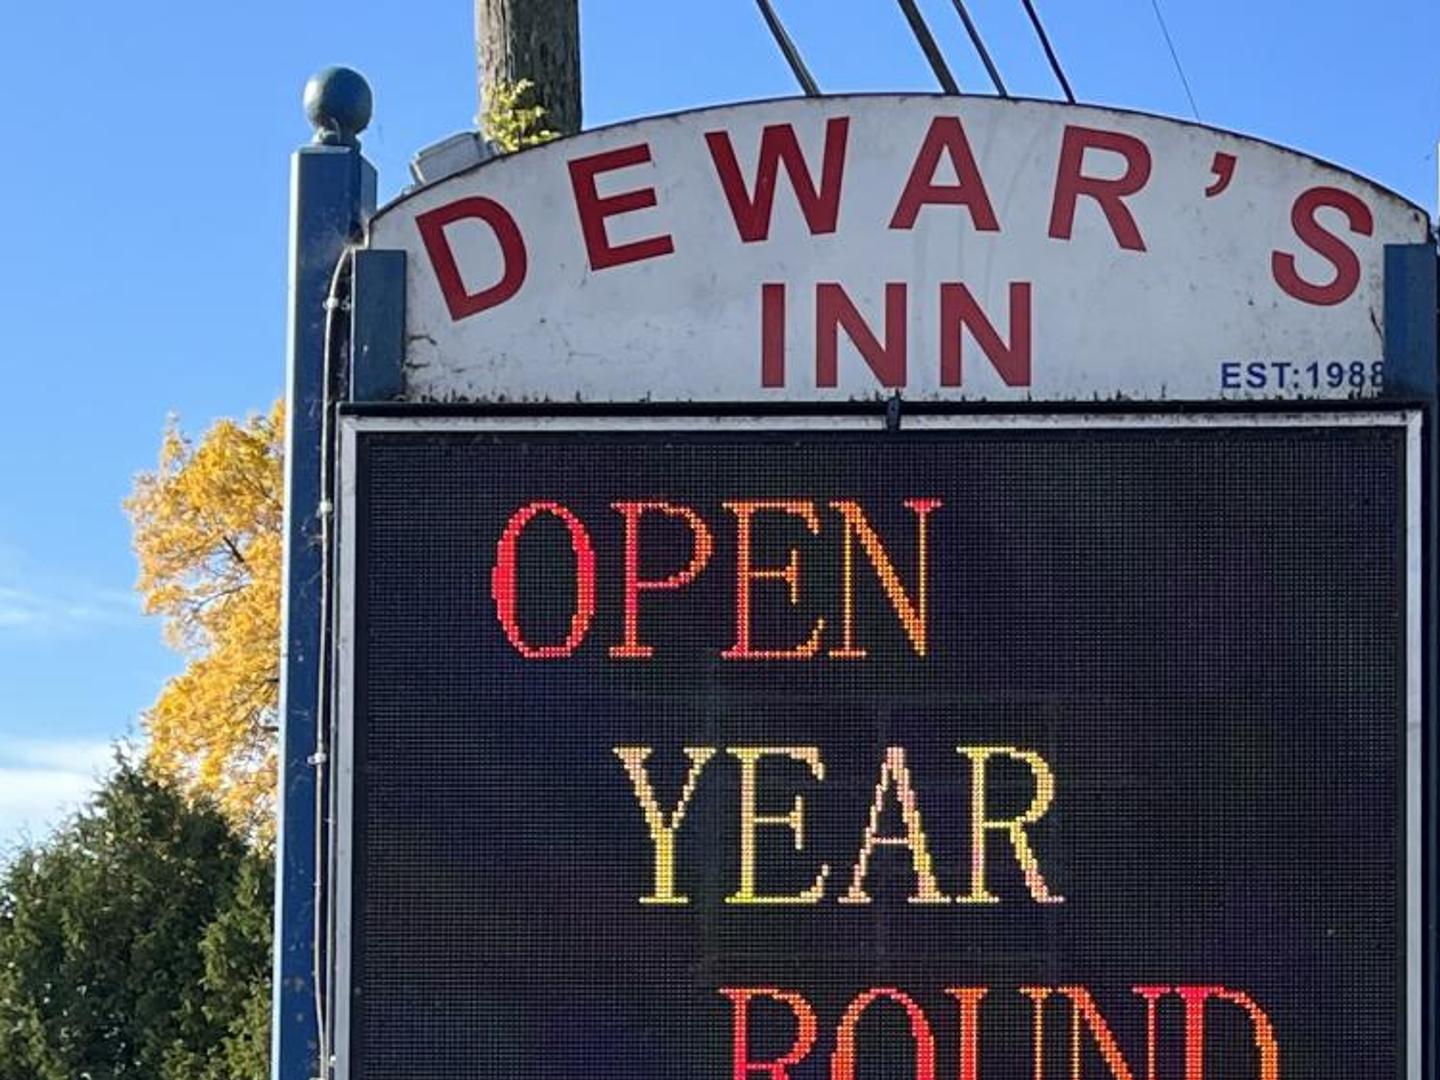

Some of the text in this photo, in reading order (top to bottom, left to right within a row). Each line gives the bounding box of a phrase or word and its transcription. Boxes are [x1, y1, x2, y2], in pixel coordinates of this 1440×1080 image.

[415, 115, 1374, 321] DEWAR'S
[761, 281, 1032, 389] INN
[491, 498, 943, 659] OPEN
[613, 745, 1065, 904] YEAR
